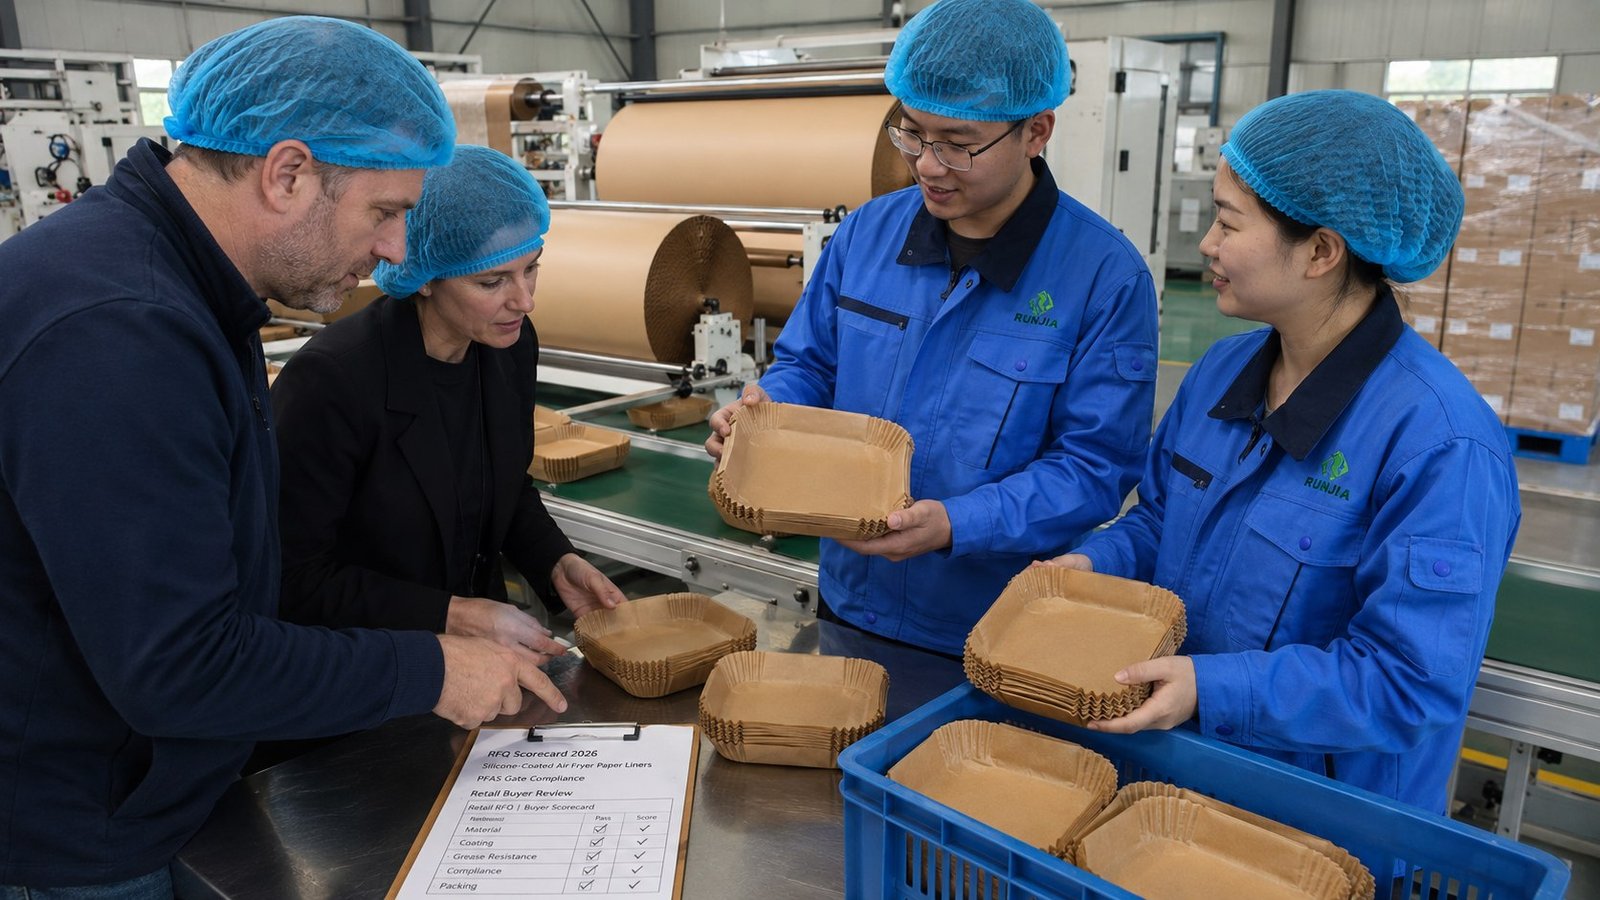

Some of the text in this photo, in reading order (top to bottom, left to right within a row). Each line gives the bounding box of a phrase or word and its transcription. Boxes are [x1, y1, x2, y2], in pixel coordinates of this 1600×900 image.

[1014, 312, 1058, 328] RUNJIA
[503, 790, 532, 798] Buyer
[446, 867, 502, 876] Compliance
[439, 882, 478, 891] Packing
